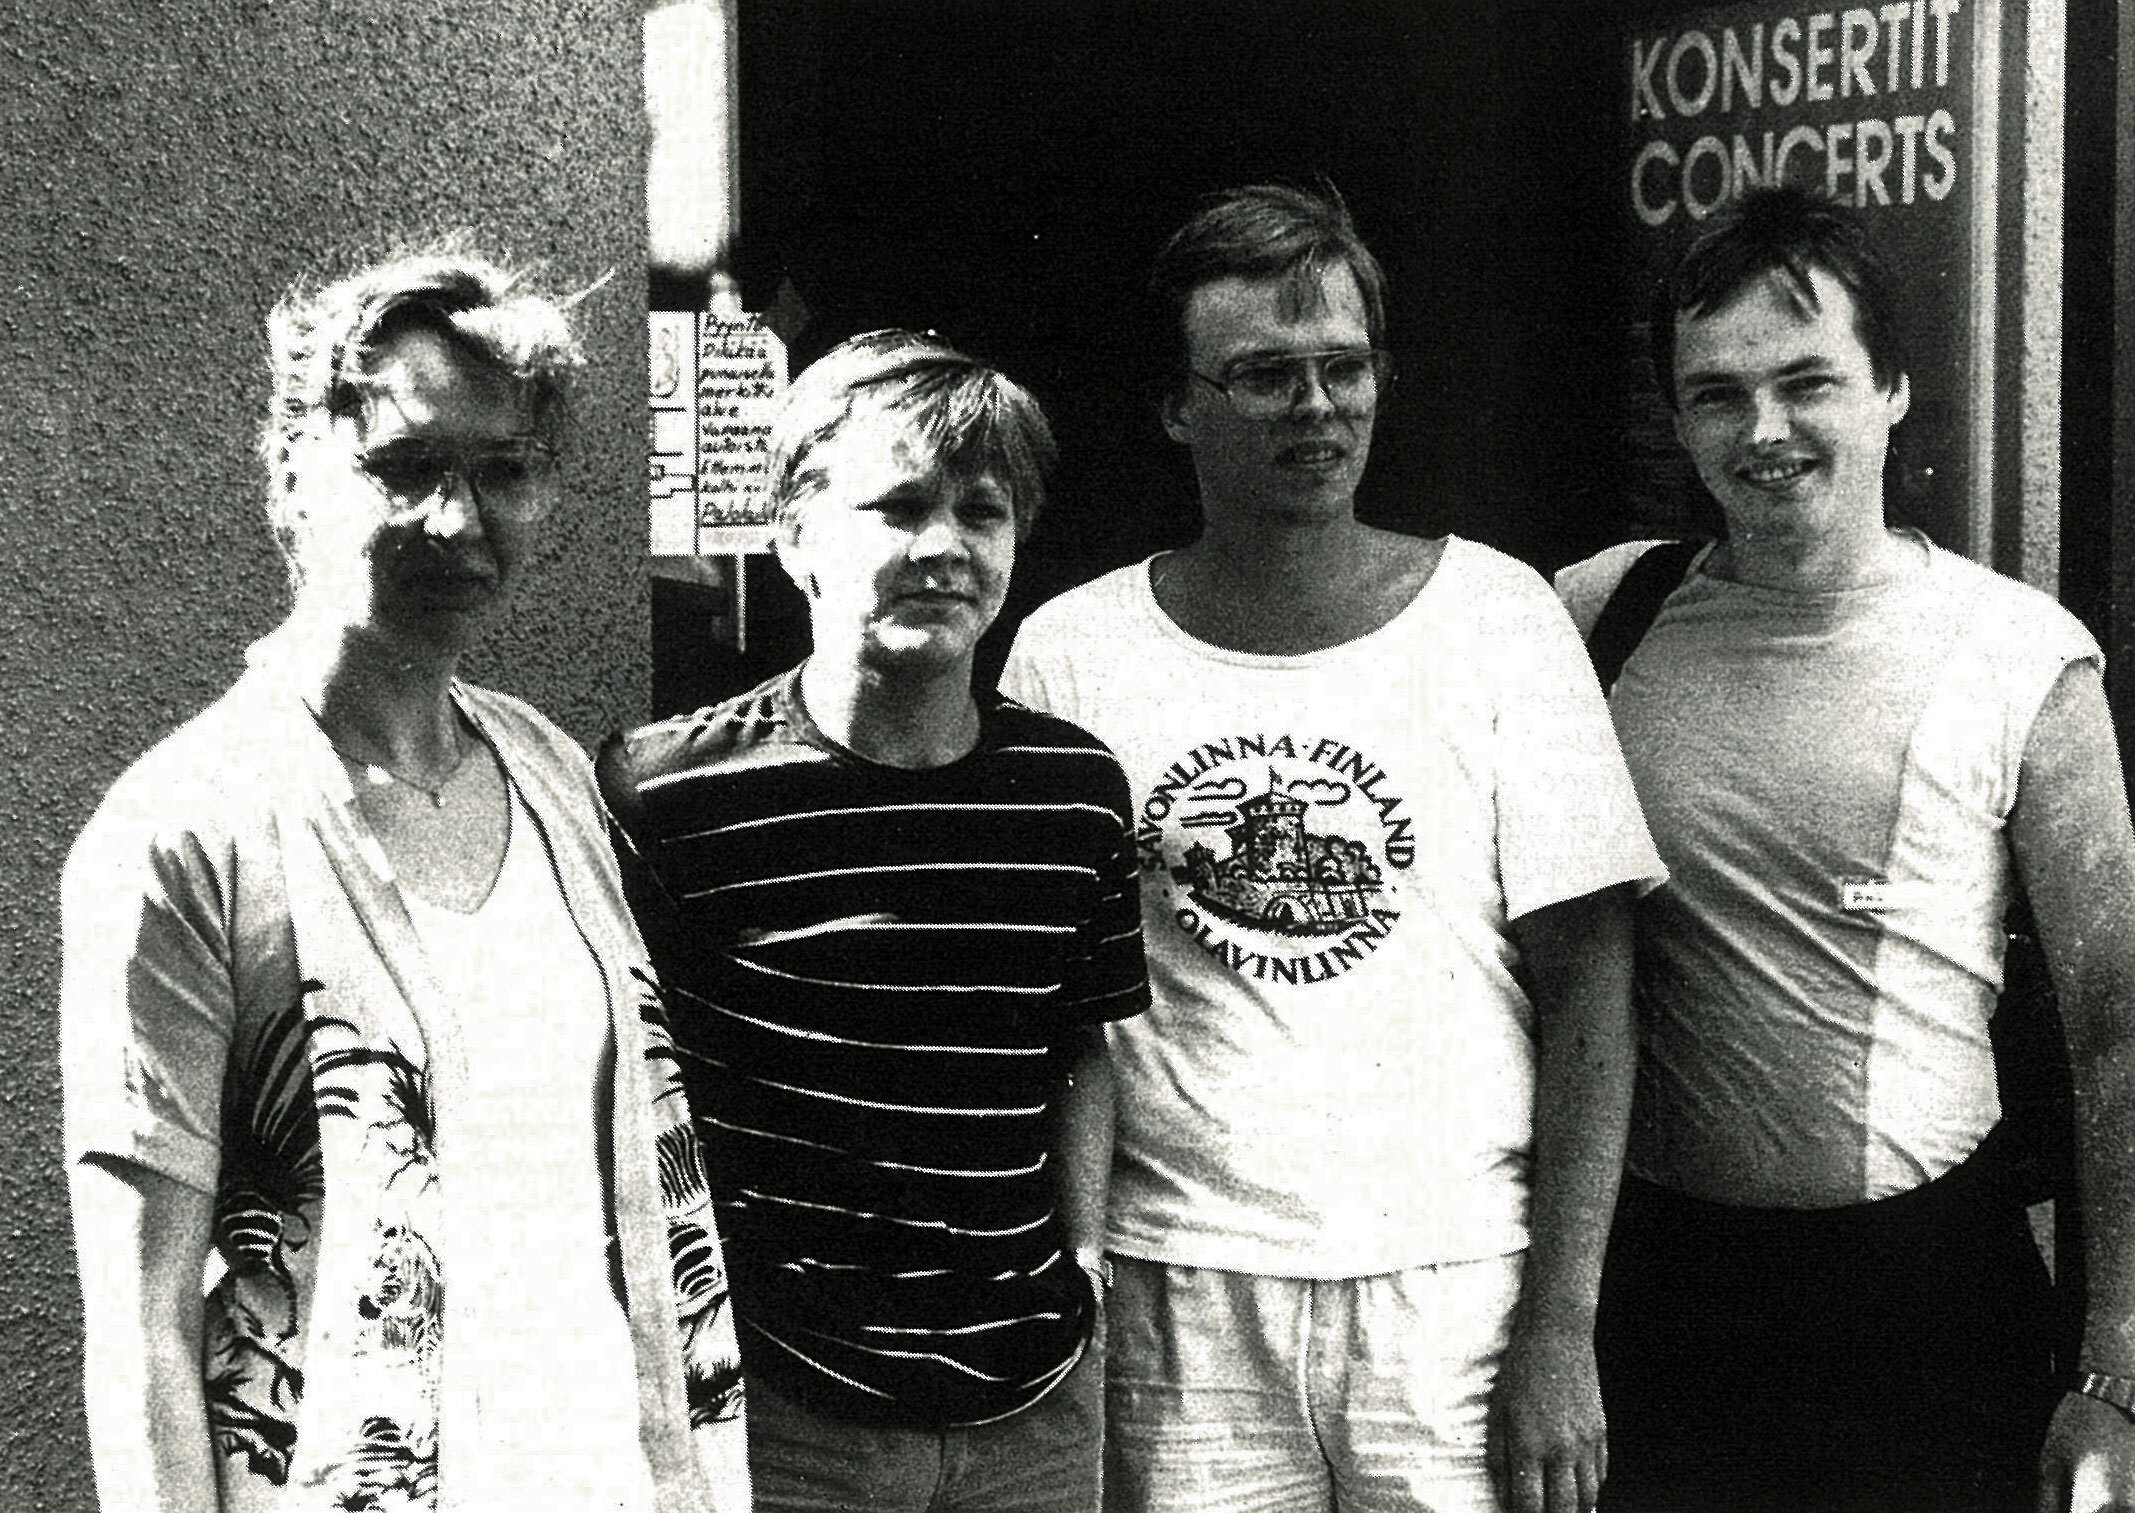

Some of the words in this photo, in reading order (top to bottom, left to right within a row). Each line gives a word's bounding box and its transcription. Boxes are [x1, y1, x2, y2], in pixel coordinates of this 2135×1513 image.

[1631, 0, 1960, 122] KONSERTIT
[1308, 737, 1416, 870] FINLAND
[1174, 908, 1402, 985] OLAVINLINNA
